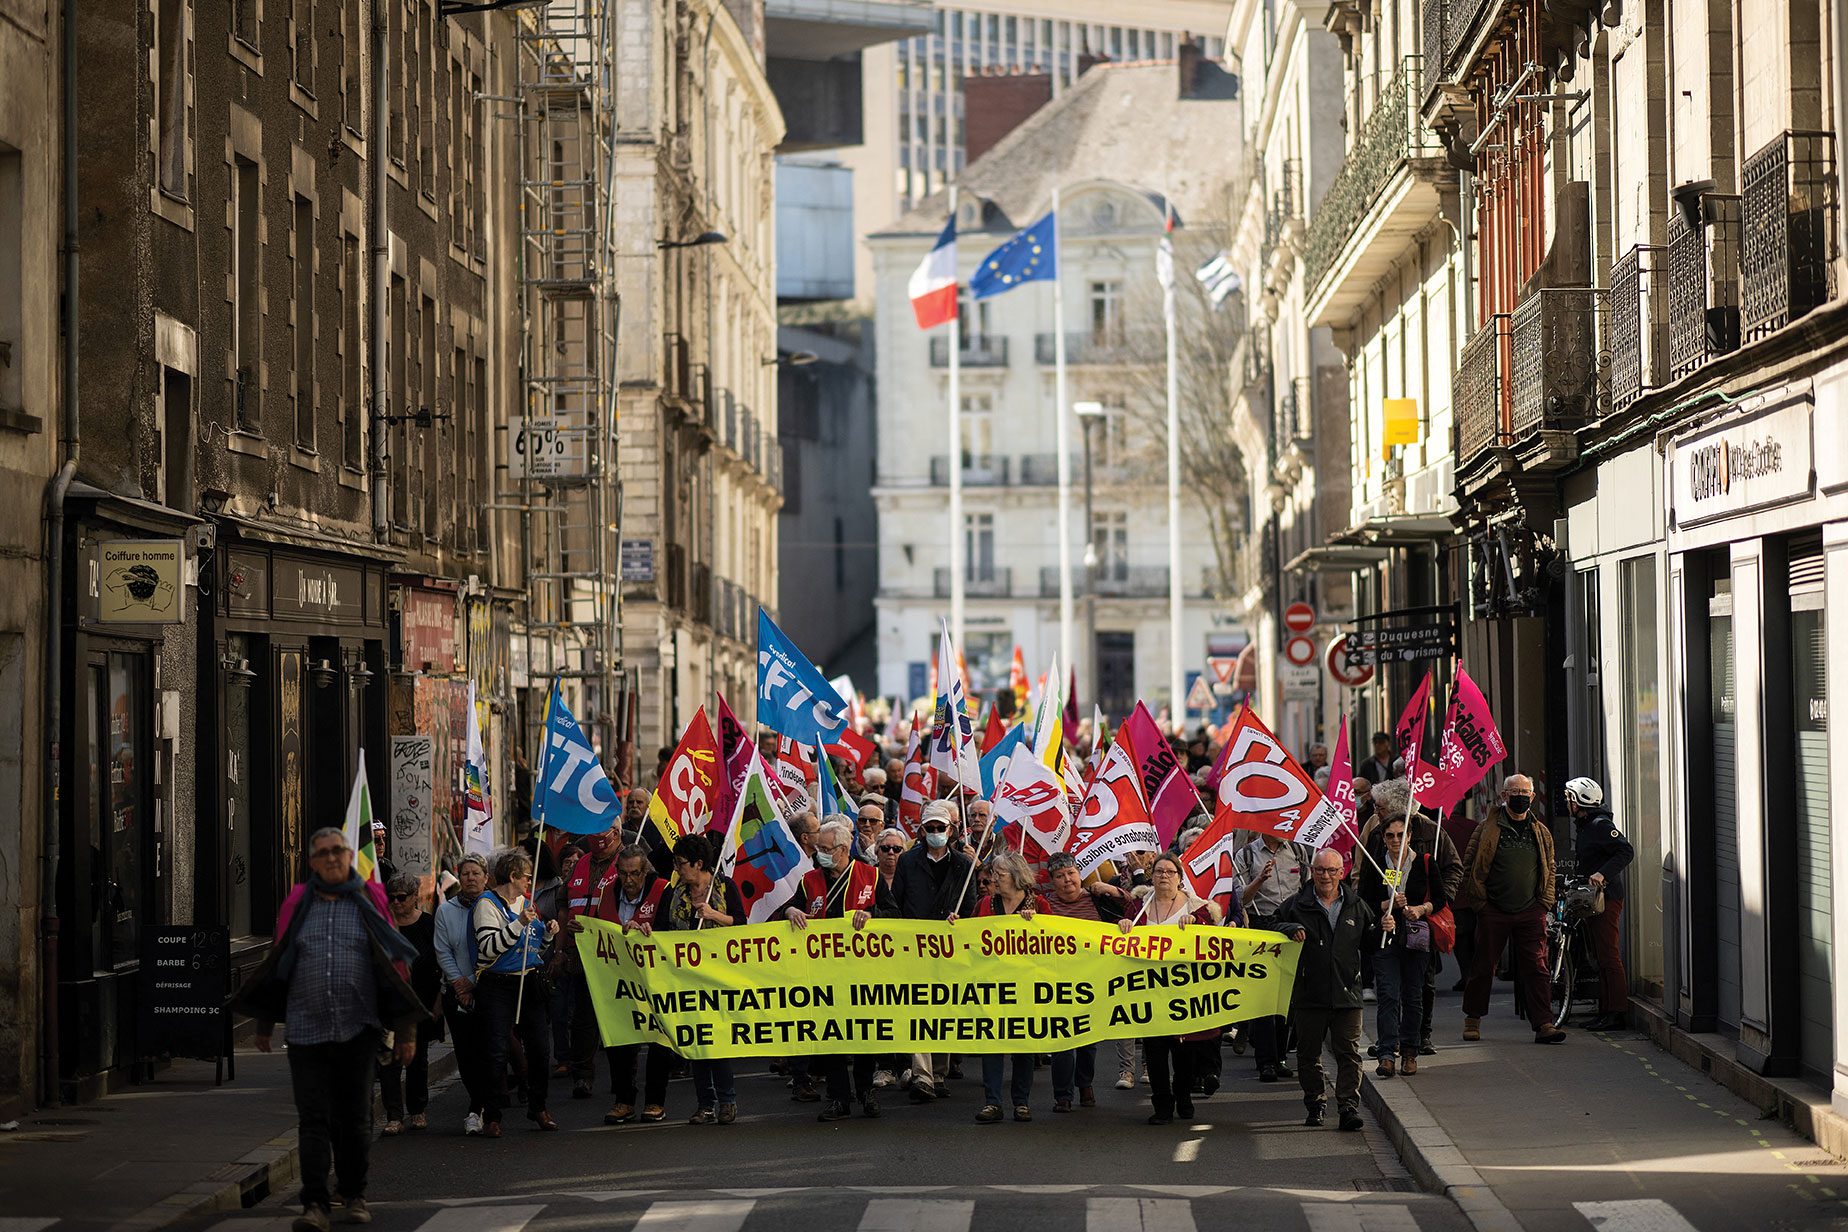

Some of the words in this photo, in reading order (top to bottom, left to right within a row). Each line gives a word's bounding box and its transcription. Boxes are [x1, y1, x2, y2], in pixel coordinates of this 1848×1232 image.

[105, 551, 140, 561] Coiffure
[142, 551, 175, 561] homme
[1380, 628, 1439, 643] Duquesne
[1381, 649, 1393, 661] du
[157, 936, 187, 944] COUPE
[674, 942, 702, 968] FO
[725, 936, 781, 964] CFTC
[806, 933, 895, 960] CFE-CGC
[915, 934, 955, 959] FSU
[981, 929, 1077, 956] Solidaires
[1100, 935, 1173, 961] FGR-FP
[1195, 935, 1235, 961] LSR
[156, 959, 186, 967] BARBE
[191, 953, 201, 970] 6
[155, 981, 192, 989] DÉFRISAGE
[850, 983, 1017, 1006] IMMEDIATE
[1034, 982, 1095, 1005] DES
[1108, 962, 1268, 997] PENSIONS
[153, 1006, 207, 1014] SHAMPOING
[675, 1023, 714, 1047] DE
[731, 1018, 894, 1045] RETRAITE
[909, 1014, 1091, 1041] INFERIEURE
[1108, 1001, 1153, 1026] AU
[1168, 988, 1241, 1021] SMIC
